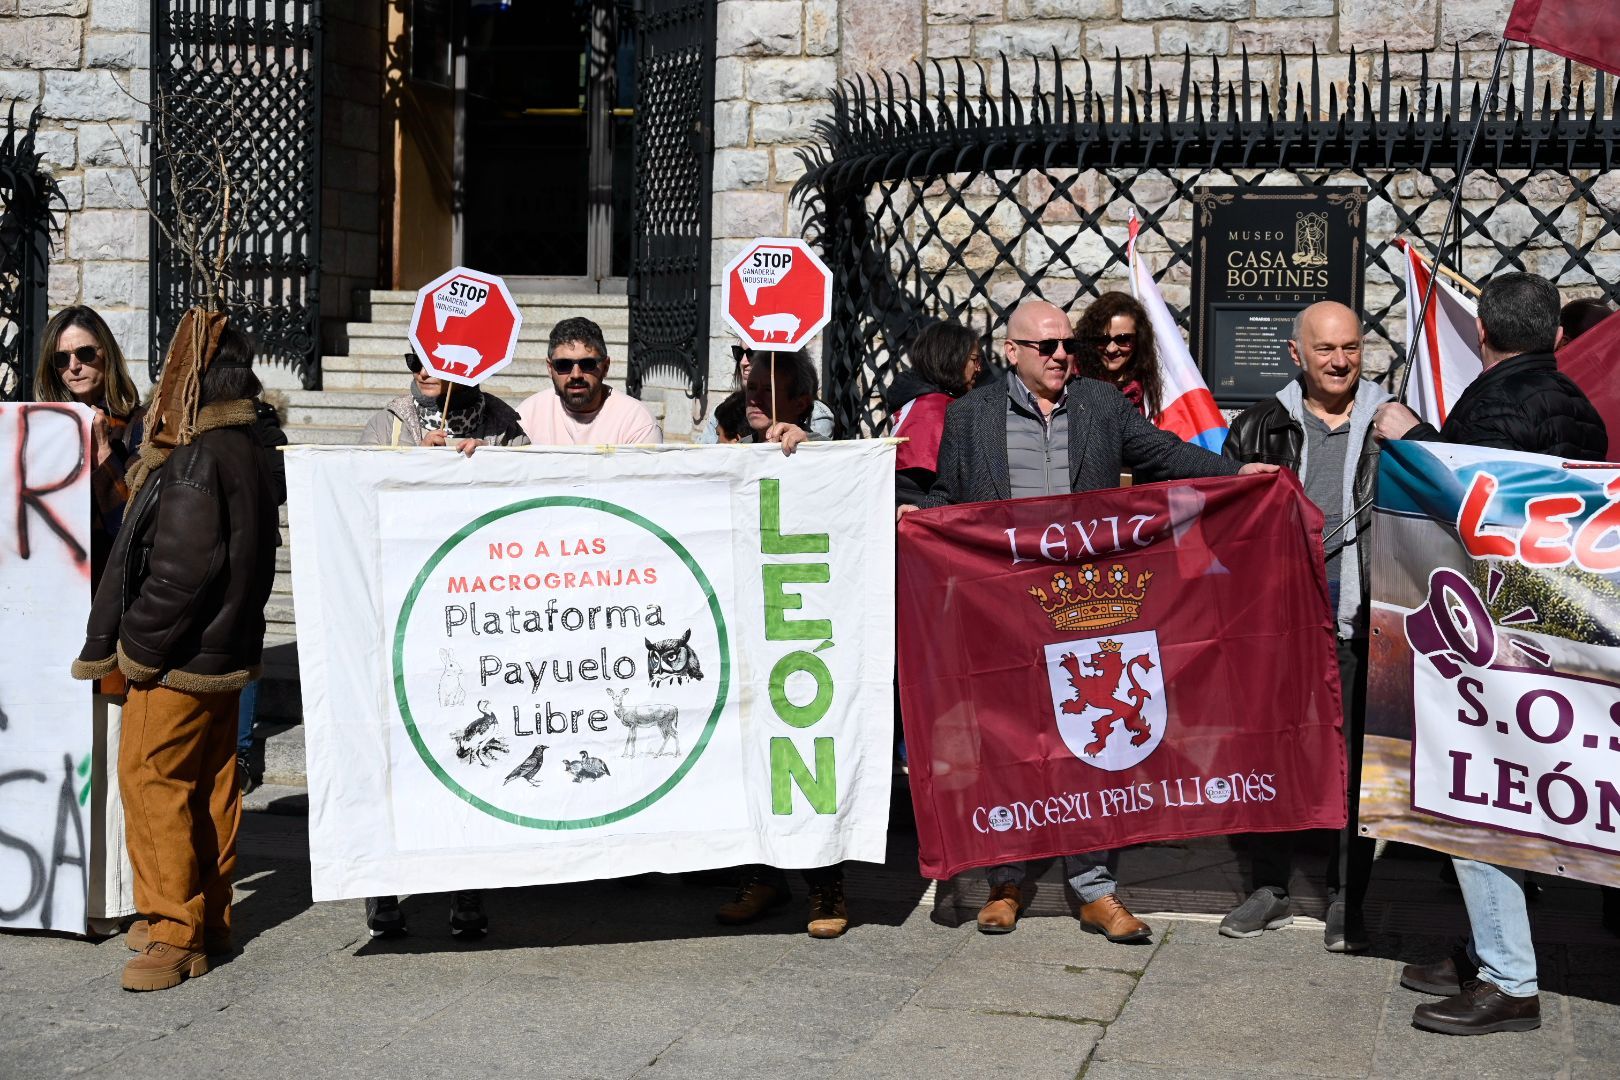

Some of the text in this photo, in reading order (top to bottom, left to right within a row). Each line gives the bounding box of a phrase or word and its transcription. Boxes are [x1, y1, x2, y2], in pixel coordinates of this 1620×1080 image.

[1229, 231, 1284, 241] MUSEO
[753, 252, 792, 268] STOP
[1227, 250, 1288, 268] CASA
[1227, 269, 1328, 288] BOTINES
[449, 281, 488, 302] STOP
[435, 302, 467, 317] INDUSTRIAL
[489, 537, 607, 560] NO A LAS
[1003, 513, 1157, 566] LEXIT
[447, 567, 658, 594] MACROGRANJAS
[445, 599, 666, 638] Plataforma
[760, 478, 837, 815] LEÓN
[479, 646, 637, 694] Payuelo
[512, 702, 609, 737] Libre
